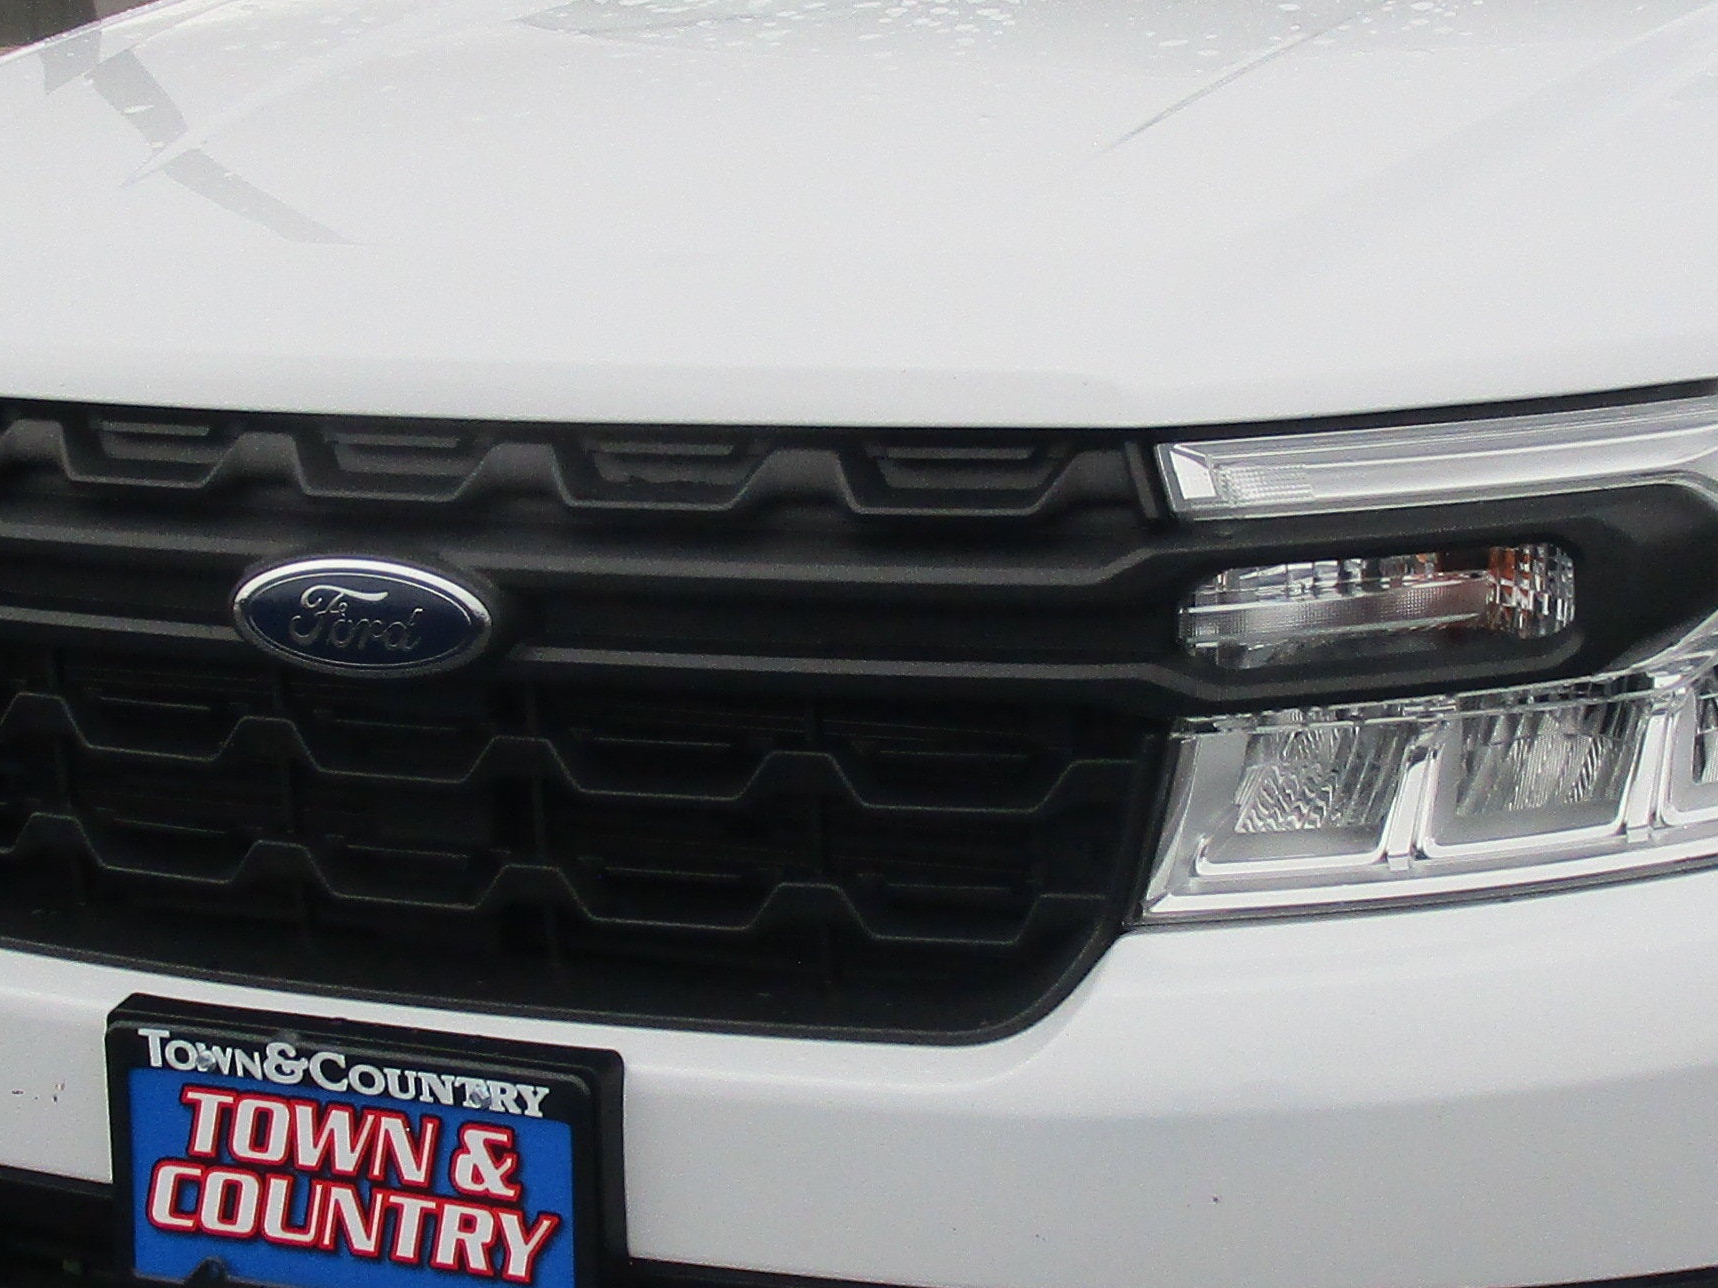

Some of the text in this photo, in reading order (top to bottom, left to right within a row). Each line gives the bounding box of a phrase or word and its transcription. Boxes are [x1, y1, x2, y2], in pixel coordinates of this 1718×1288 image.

[288, 584, 424, 650] Ford
[182, 1086, 523, 1200] TOWN &
[148, 1159, 560, 1284] COUNTRY
